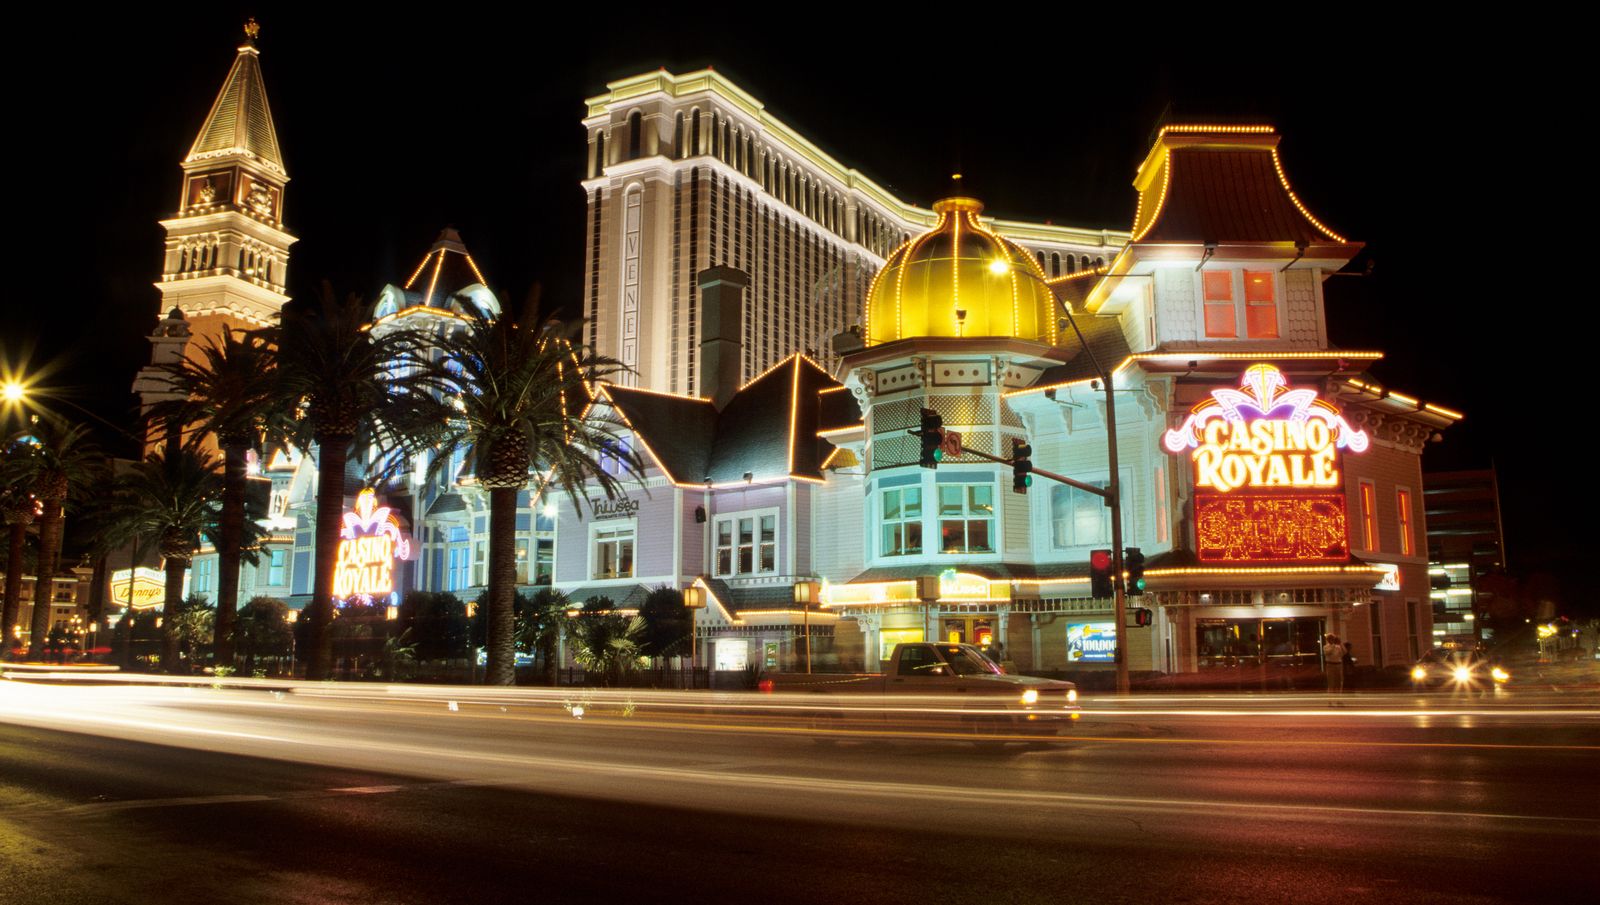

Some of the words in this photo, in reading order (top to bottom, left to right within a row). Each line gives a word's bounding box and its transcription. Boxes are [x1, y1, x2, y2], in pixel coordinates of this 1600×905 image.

[1203, 417, 1332, 456] CASINO
[1192, 445, 1338, 492] ROYALE
[337, 534, 393, 568] CASINO
[332, 560, 393, 600] ROYALE
